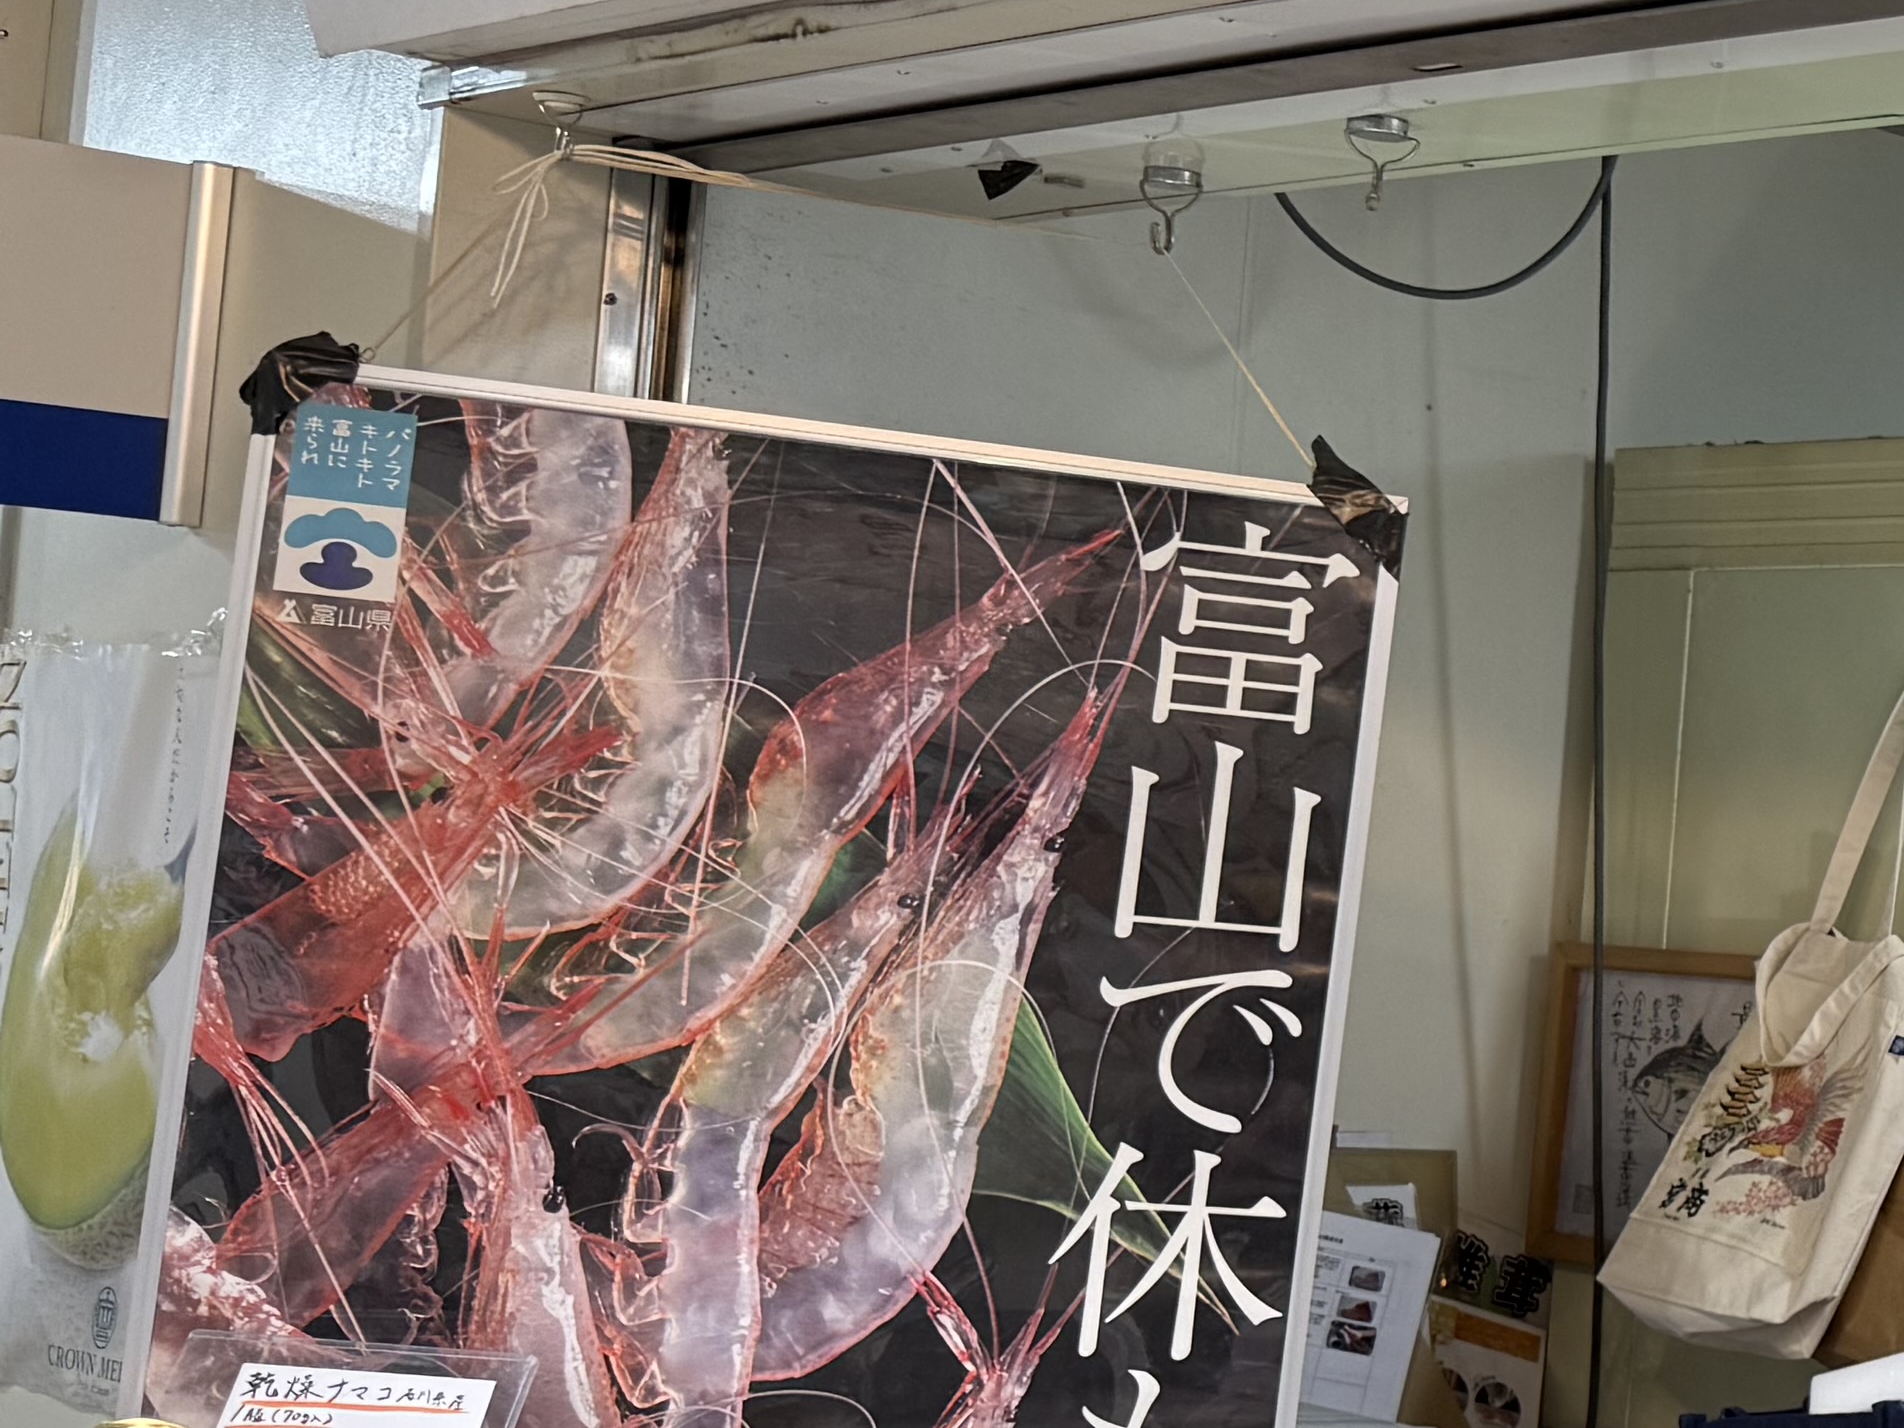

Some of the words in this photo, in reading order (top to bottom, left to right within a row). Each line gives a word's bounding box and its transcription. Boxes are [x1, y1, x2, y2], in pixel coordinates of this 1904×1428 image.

[301, 416, 324, 464] 来られ
[328, 419, 352, 468] 富山に
[356, 425, 378, 489] キトキト
[382, 428, 411, 491] パノラマ
[311, 604, 393, 630] 富山県
[47, 1344, 97, 1373] CROWN
[240, 1372, 392, 1403] 乾燥ナマコ
